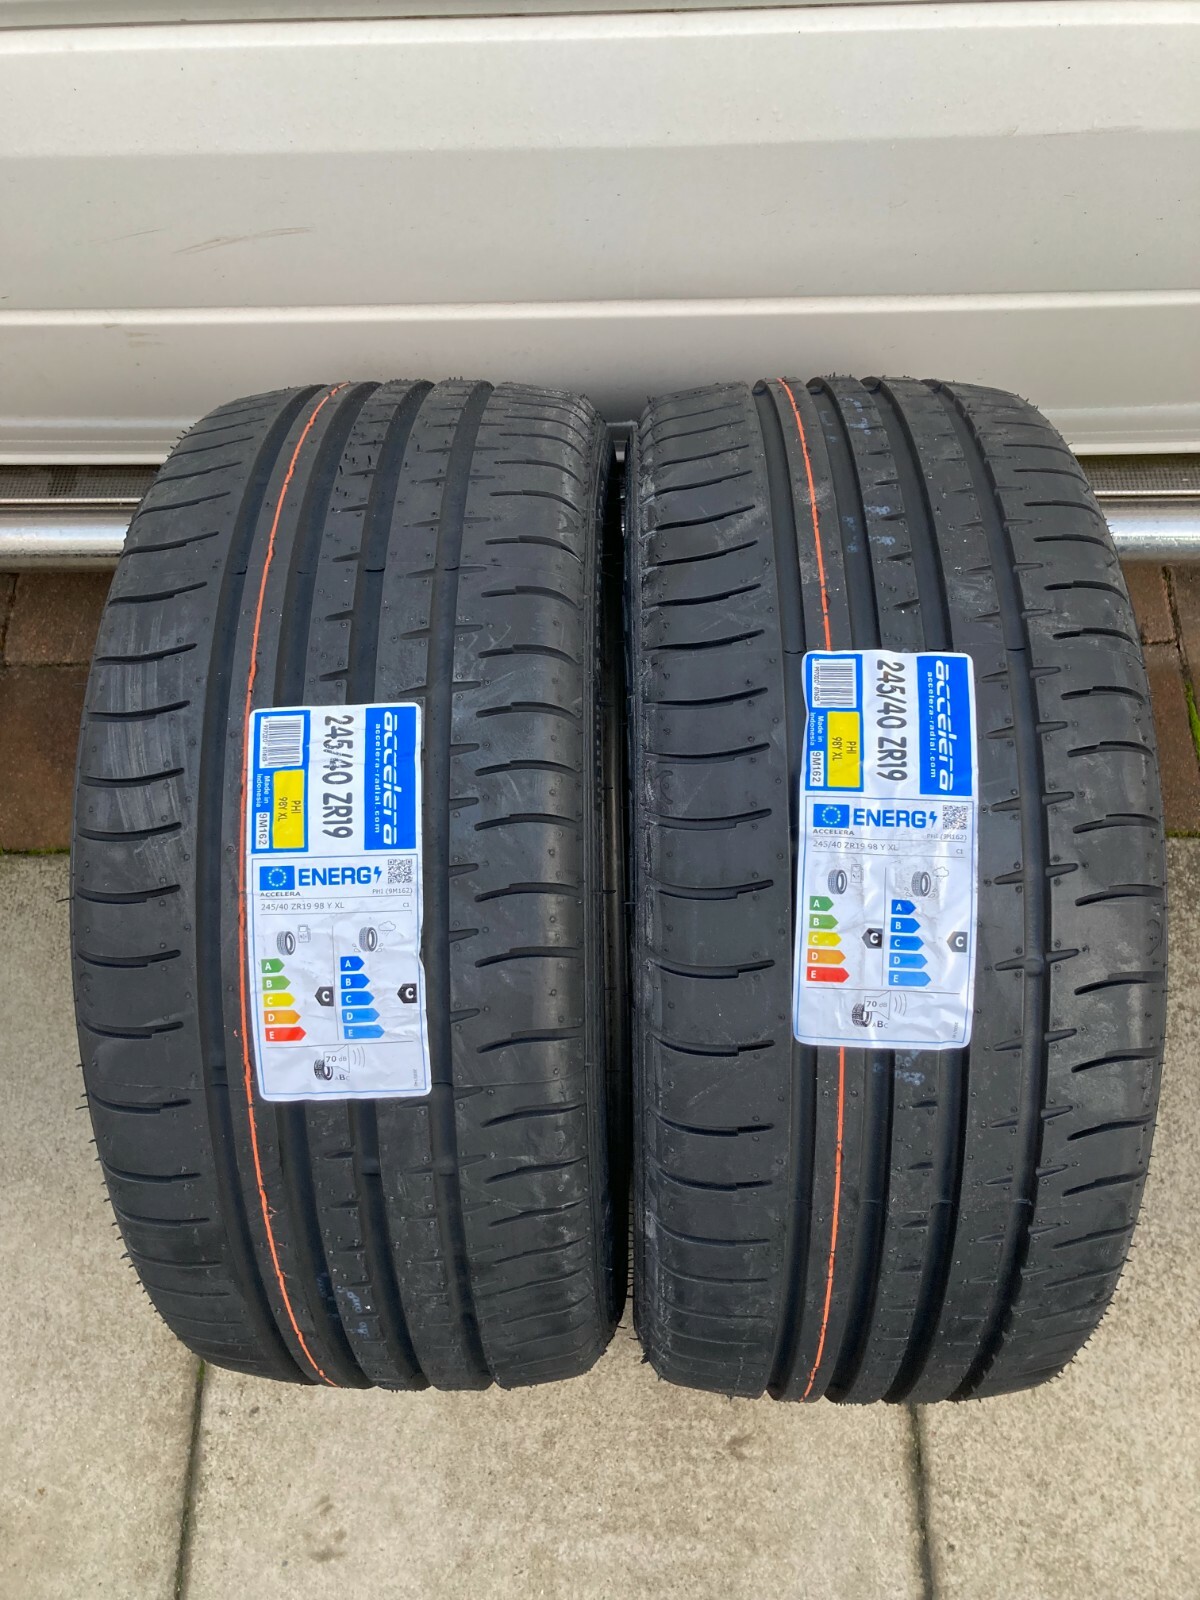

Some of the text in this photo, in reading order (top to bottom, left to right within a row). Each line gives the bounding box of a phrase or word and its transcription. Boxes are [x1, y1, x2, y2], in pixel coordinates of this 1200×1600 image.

[876, 659, 908, 781] 245/40 ZR19
[927, 671, 936, 778] accelera-radial.com
[809, 712, 817, 746] Indonesia
[935, 660, 957, 791] accelera
[832, 736, 842, 761] 98Y XL
[846, 741, 857, 754] PHI
[812, 751, 822, 783] 9M162
[322, 715, 354, 838] 245/40 ZR19
[383, 711, 402, 845] accelera
[278, 797, 288, 822] 98Y XL
[291, 800, 301, 814] PHI
[853, 808, 927, 829] ENERG
[258, 813, 268, 845] 9M162
[813, 828, 855, 836] ACCELERA
[813, 840, 842, 849] 245/40
[844, 841, 865, 849] ZR19
[887, 843, 898, 851] XL
[299, 866, 371, 886] ENERG
[261, 903, 289, 911] 245/40
[314, 902, 325, 910] 98
[813, 900, 820, 908] A
[813, 918, 819, 926] B
[895, 922, 901, 930] B
[812, 935, 818, 943] C
[869, 932, 878, 944] C
[955, 936, 964, 947] C
[894, 939, 900, 947] C
[812, 952, 818, 960] D
[265, 962, 272, 971] A
[345, 960, 352, 968] A
[811, 970, 816, 978] E
[266, 980, 273, 988] B
[345, 978, 351, 986] B
[321, 991, 330, 1001] C
[405, 988, 414, 999] C
[267, 997, 273, 1005] C
[345, 995, 352, 1004] C
[268, 1014, 275, 1022] D
[346, 1012, 353, 1020] D
[269, 1031, 275, 1040] E
[348, 1029, 353, 1037] E
